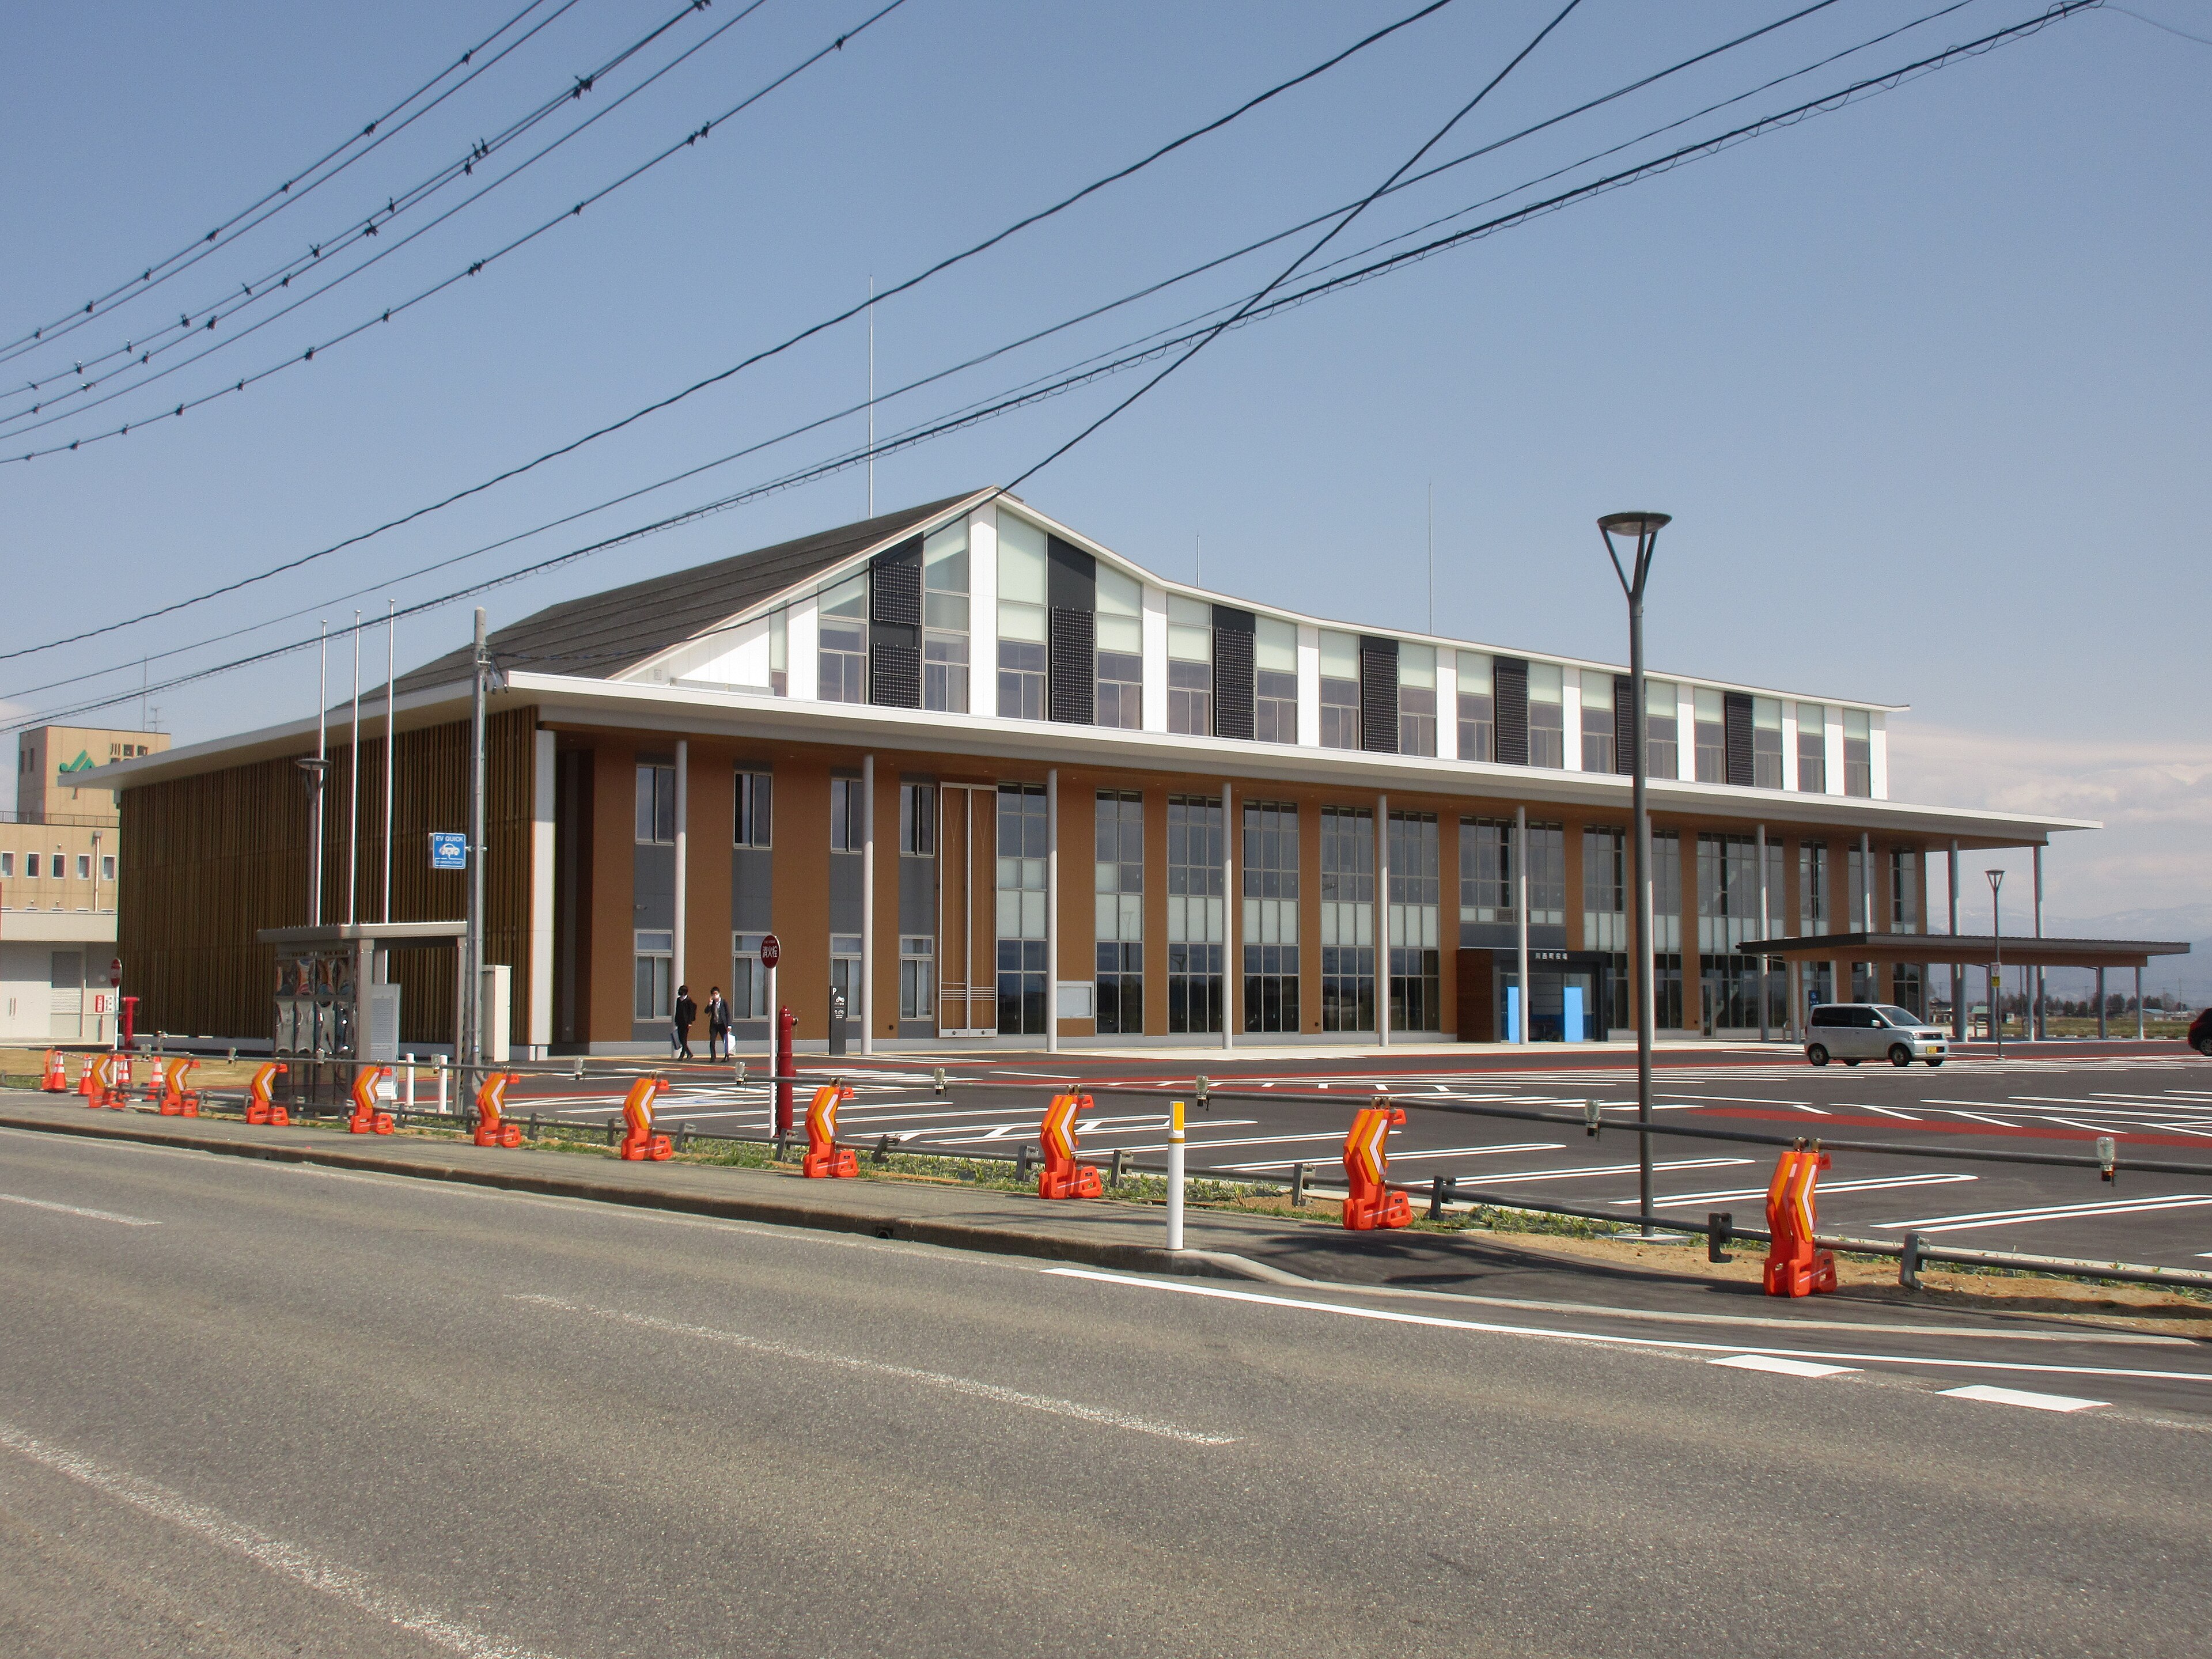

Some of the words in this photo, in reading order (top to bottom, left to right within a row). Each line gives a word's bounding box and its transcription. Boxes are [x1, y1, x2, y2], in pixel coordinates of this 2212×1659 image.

[762, 945, 778, 958] 消火栓
[832, 987, 837, 995] P
